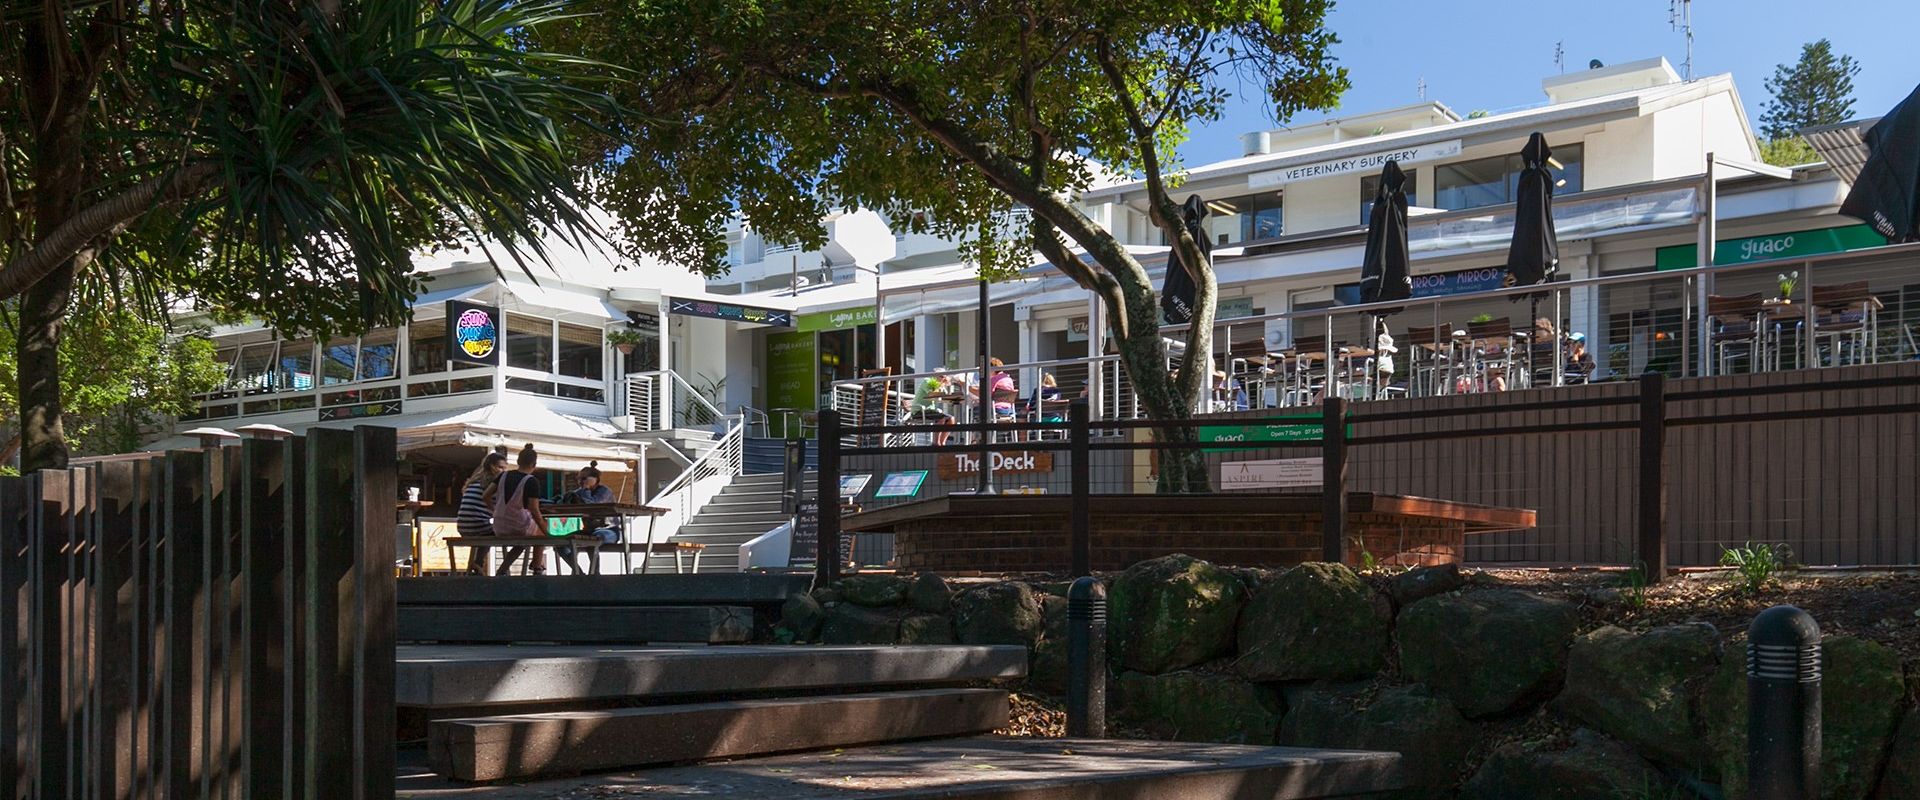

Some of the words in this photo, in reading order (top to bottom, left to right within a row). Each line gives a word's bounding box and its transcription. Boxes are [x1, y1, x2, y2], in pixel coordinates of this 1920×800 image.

[1286, 160, 1356, 179] VETERINARY
[1360, 150, 1418, 170] SURGERY
[1741, 236, 1794, 260] guaco
[1411, 274, 1446, 289] IRROR
[1456, 268, 1499, 284] MIRROR
[991, 451, 1035, 471] Deck
